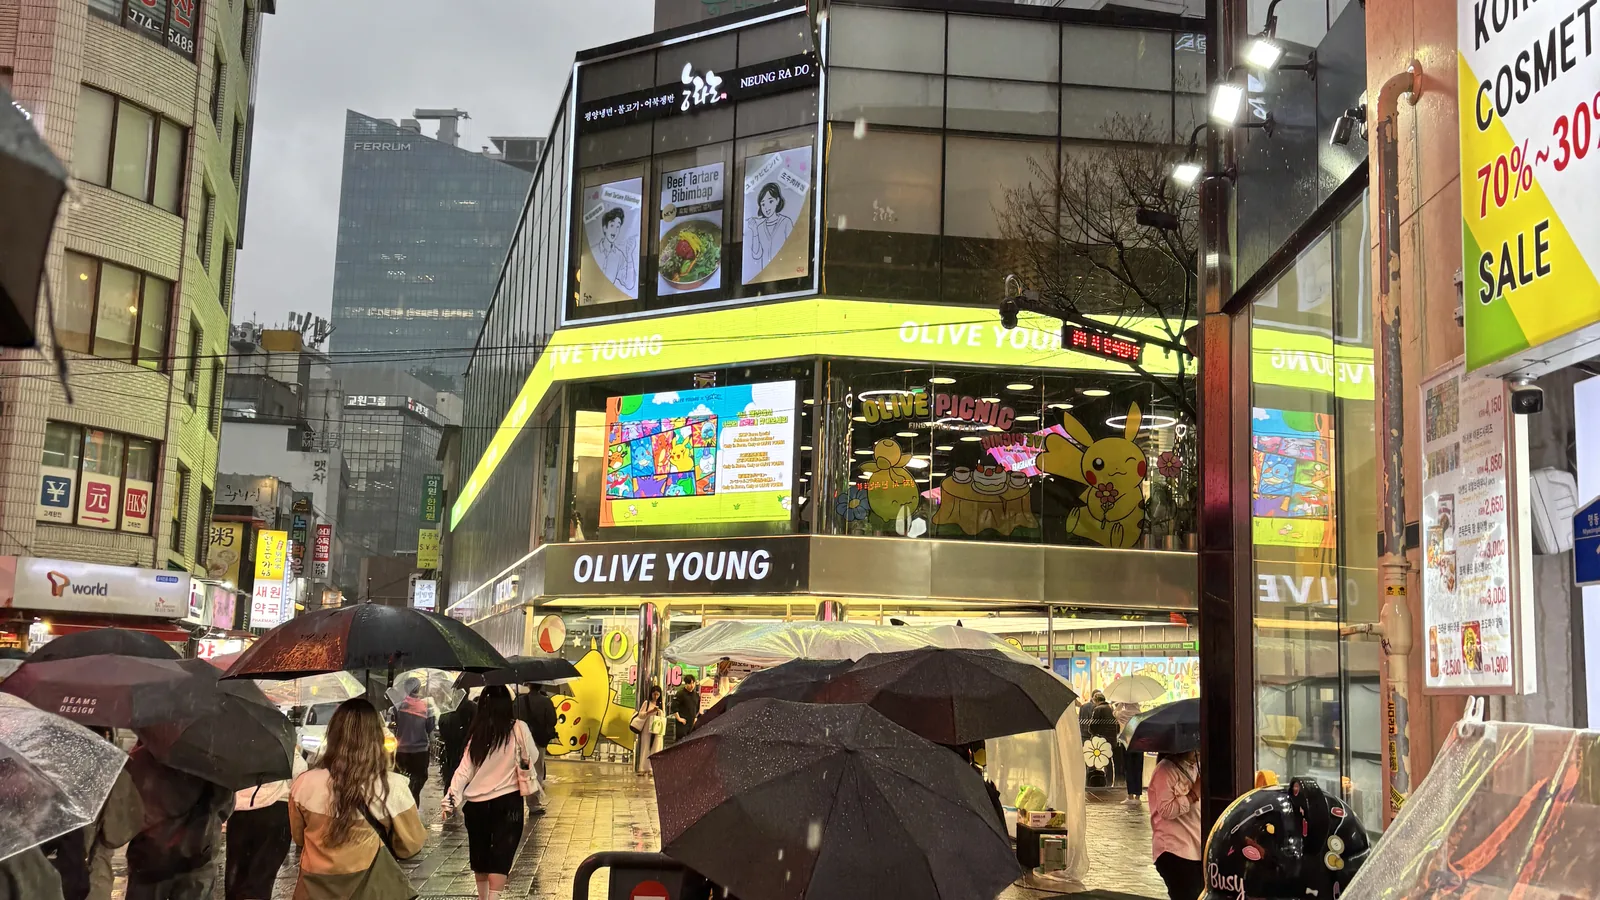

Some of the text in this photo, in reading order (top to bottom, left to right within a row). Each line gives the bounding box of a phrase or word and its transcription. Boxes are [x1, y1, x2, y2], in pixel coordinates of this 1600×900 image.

[740, 64, 810, 89] NEUNG RA DO
[353, 142, 412, 152] FERRUM
[667, 171, 719, 190] Beef Tartare
[671, 186, 713, 203] Bibimbap
[1479, 219, 1551, 306] SALE
[900, 320, 984, 347] OLIVE
[591, 333, 663, 362] YOUNG
[348, 395, 387, 407] 교원그룹
[862, 392, 1016, 431] OLIVE PICNIC
[88, 487, 108, 509] 元
[127, 493, 147, 515] HK$
[210, 526, 235, 547] 粥
[573, 549, 770, 583] OLIVE YOUNG
[72, 582, 108, 597] world
[256, 586, 281, 599] 새원
[254, 603, 279, 616] 약국
[59, 705, 96, 715] DESIGN
[63, 696, 97, 705] BEAMS
[1208, 862, 1246, 900] Busy
